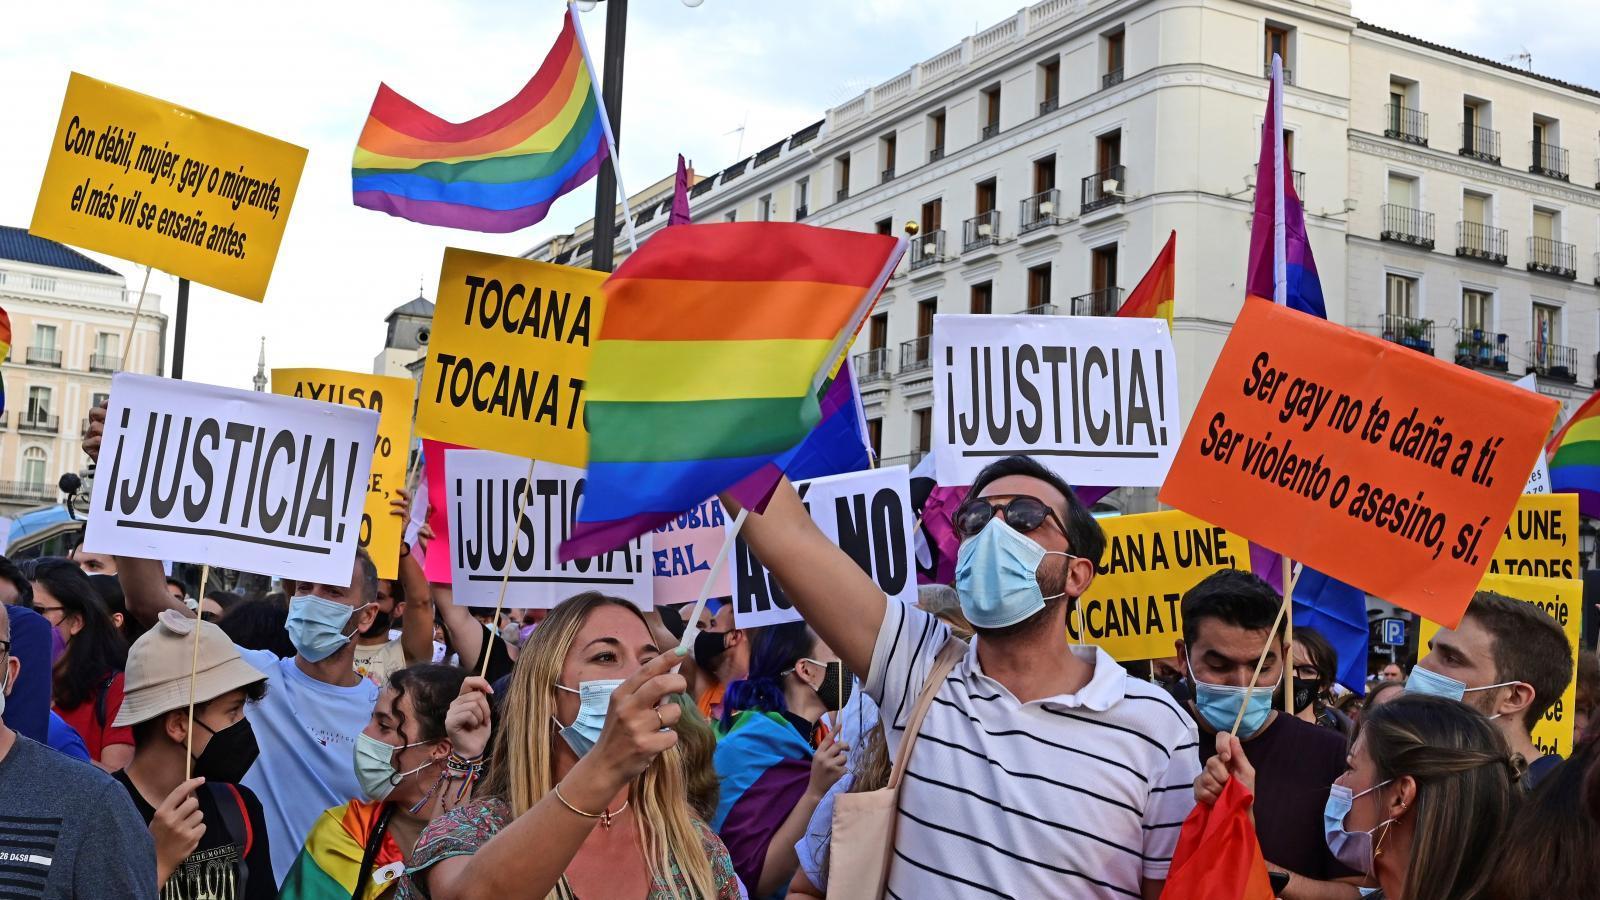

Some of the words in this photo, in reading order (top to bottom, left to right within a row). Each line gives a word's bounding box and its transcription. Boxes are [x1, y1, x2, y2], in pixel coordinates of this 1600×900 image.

[65, 116, 95, 156] Con
[95, 126, 136, 174] débil,
[135, 142, 179, 187] mujer,
[177, 158, 209, 197] gay
[208, 168, 219, 192] o
[218, 166, 280, 219] migrante,
[71, 178, 90, 212] el
[85, 184, 118, 220] más
[119, 191, 142, 225] vil
[137, 203, 156, 230] se
[158, 208, 207, 246] ensaña
[207, 223, 246, 259] antes.
[946, 344, 1167, 446] ¡JUSTICIA!
[1244, 352, 1288, 404] Ser
[1279, 378, 1332, 432] gay
[1328, 394, 1362, 433] no
[1361, 397, 1390, 444] te
[1390, 408, 1452, 468] daña
[1451, 440, 1473, 477] a
[1472, 437, 1504, 487] tí.
[104, 408, 359, 543] ¡JUSTICIA!
[1201, 412, 1244, 464] Ser
[1242, 432, 1330, 500] violento
[1330, 475, 1350, 508] o
[1348, 483, 1446, 560] asesino,
[1452, 516, 1490, 566] sí.
[1151, 532, 1169, 570] A
[1174, 527, 1235, 570] UNE,
[1517, 510, 1567, 547] UNE,
[1146, 596, 1164, 634] A
[1389, 623, 1400, 642] P
